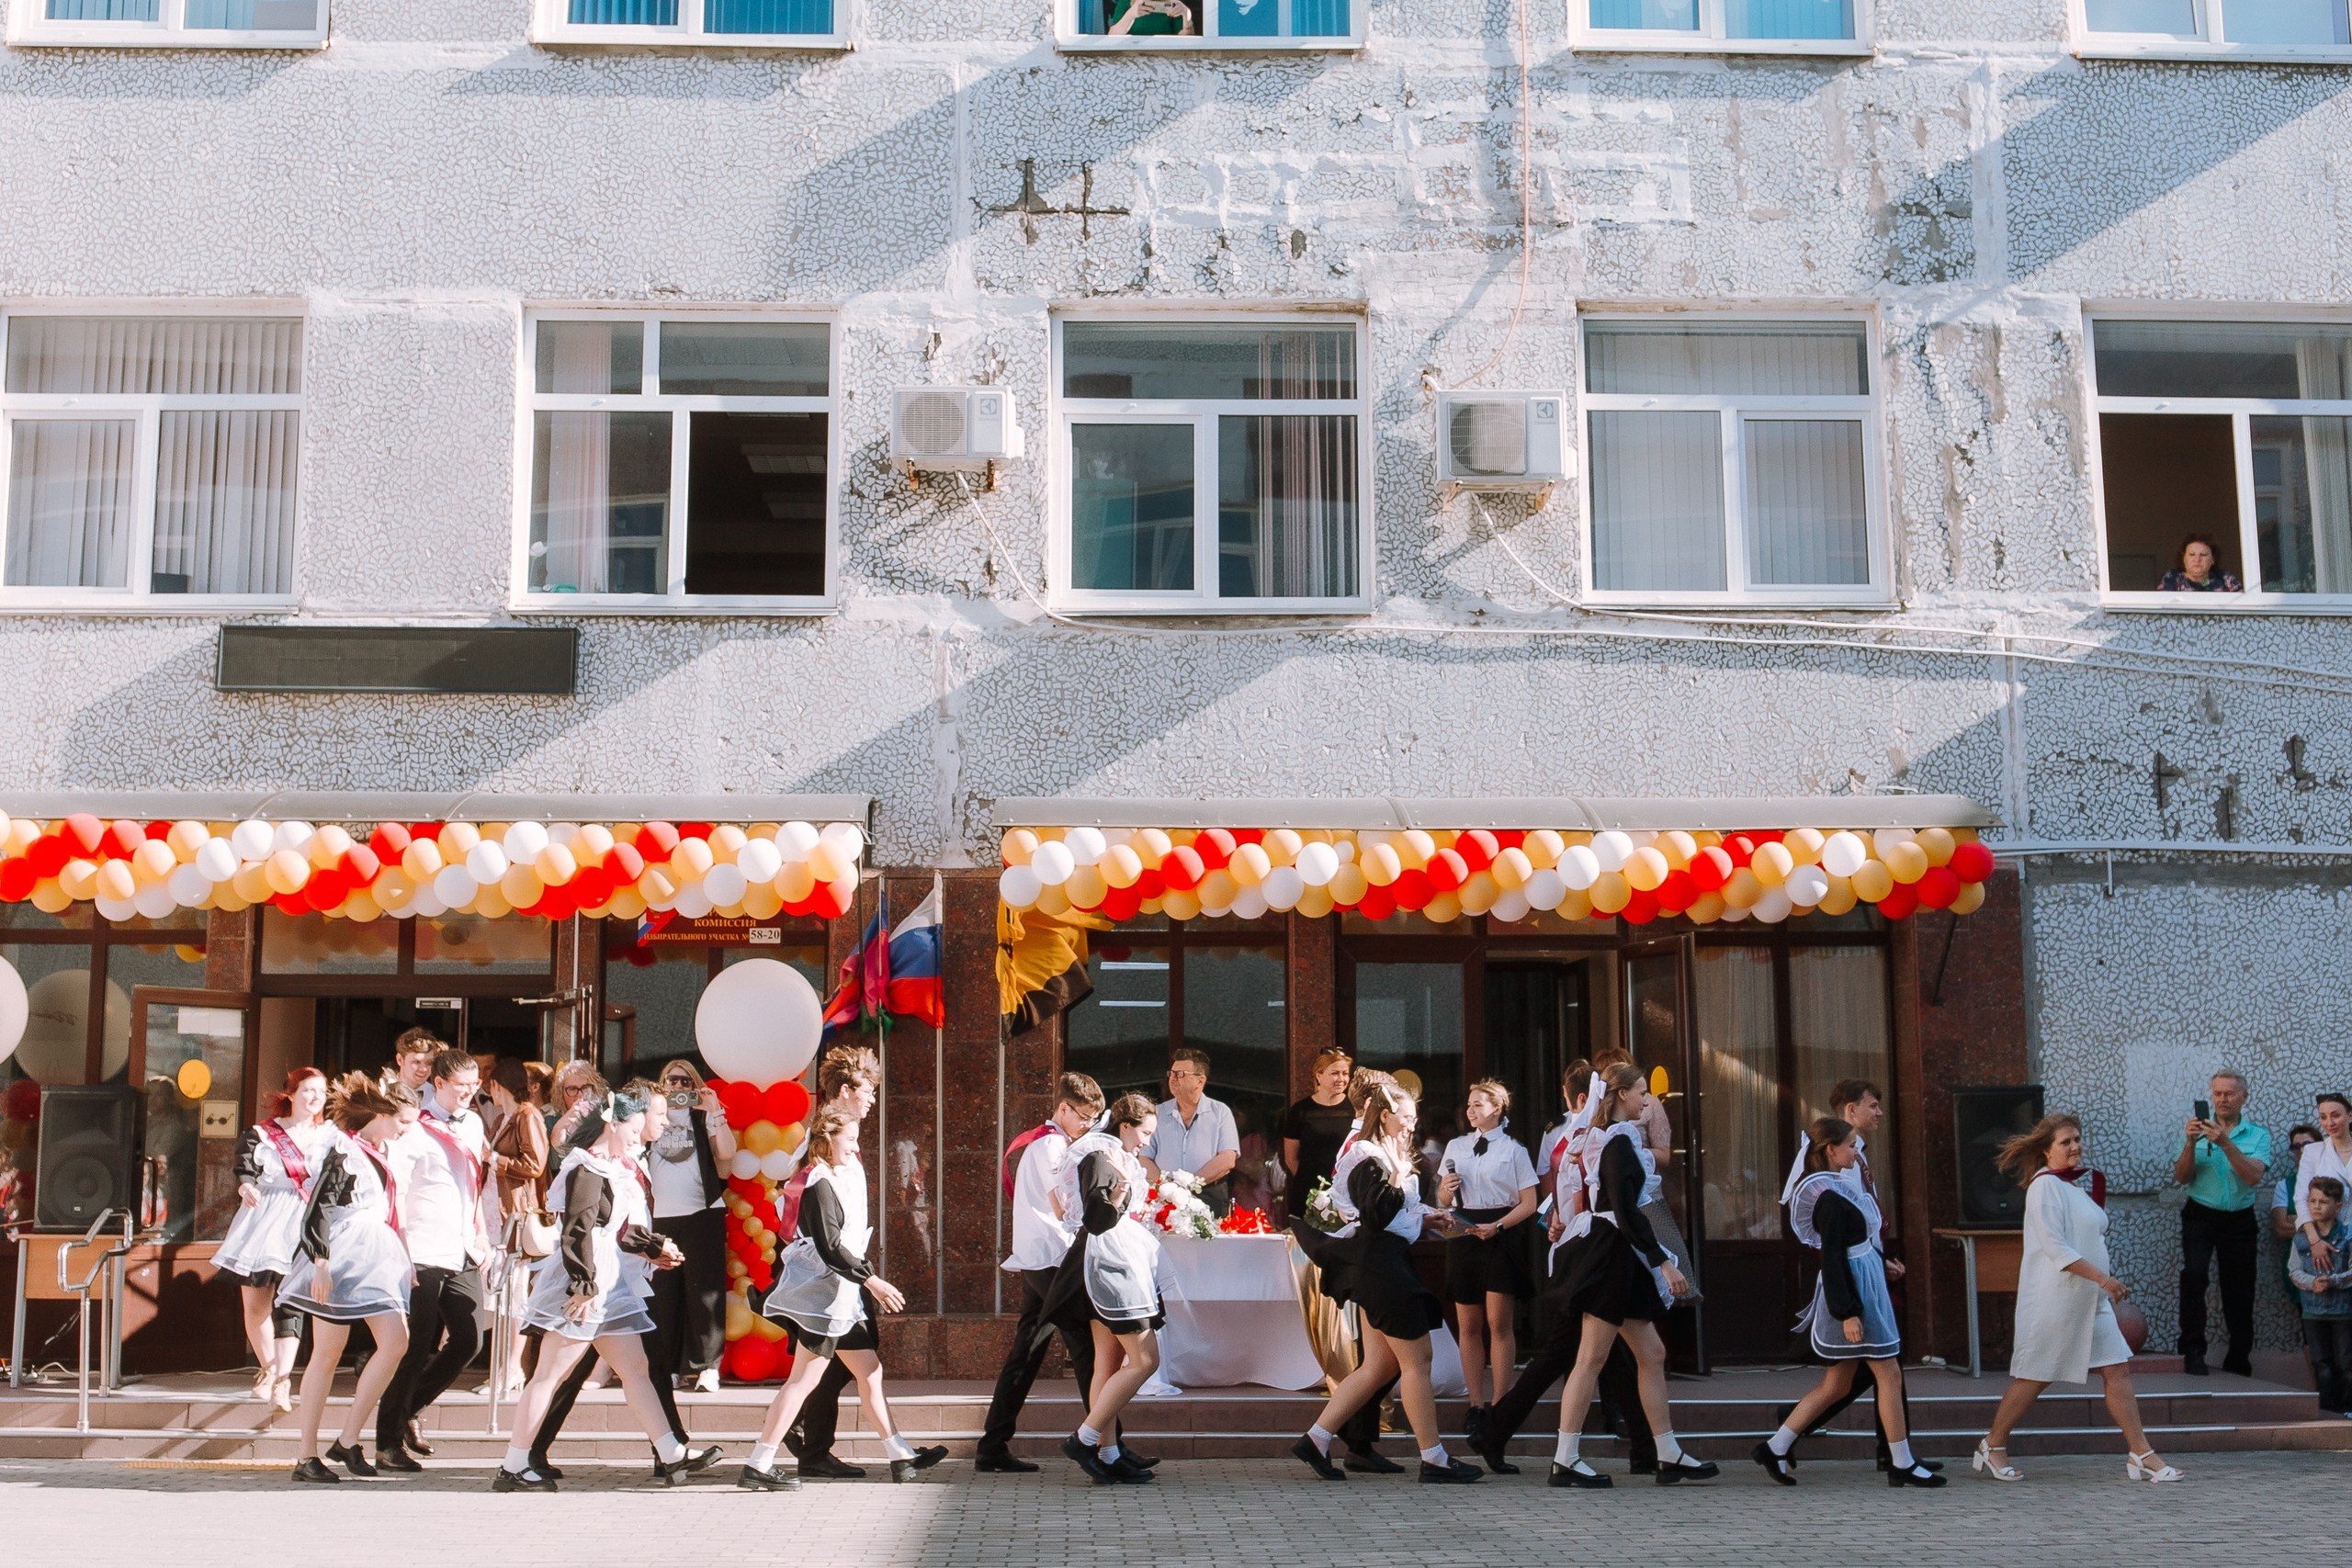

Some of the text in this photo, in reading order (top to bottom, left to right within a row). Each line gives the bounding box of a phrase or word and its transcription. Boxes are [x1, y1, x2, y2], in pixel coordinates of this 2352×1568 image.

[694, 919, 757, 927] КОМИССИЯ
[751, 930, 780, 940] 58-20
[672, 1140, 694, 1148] MOON
